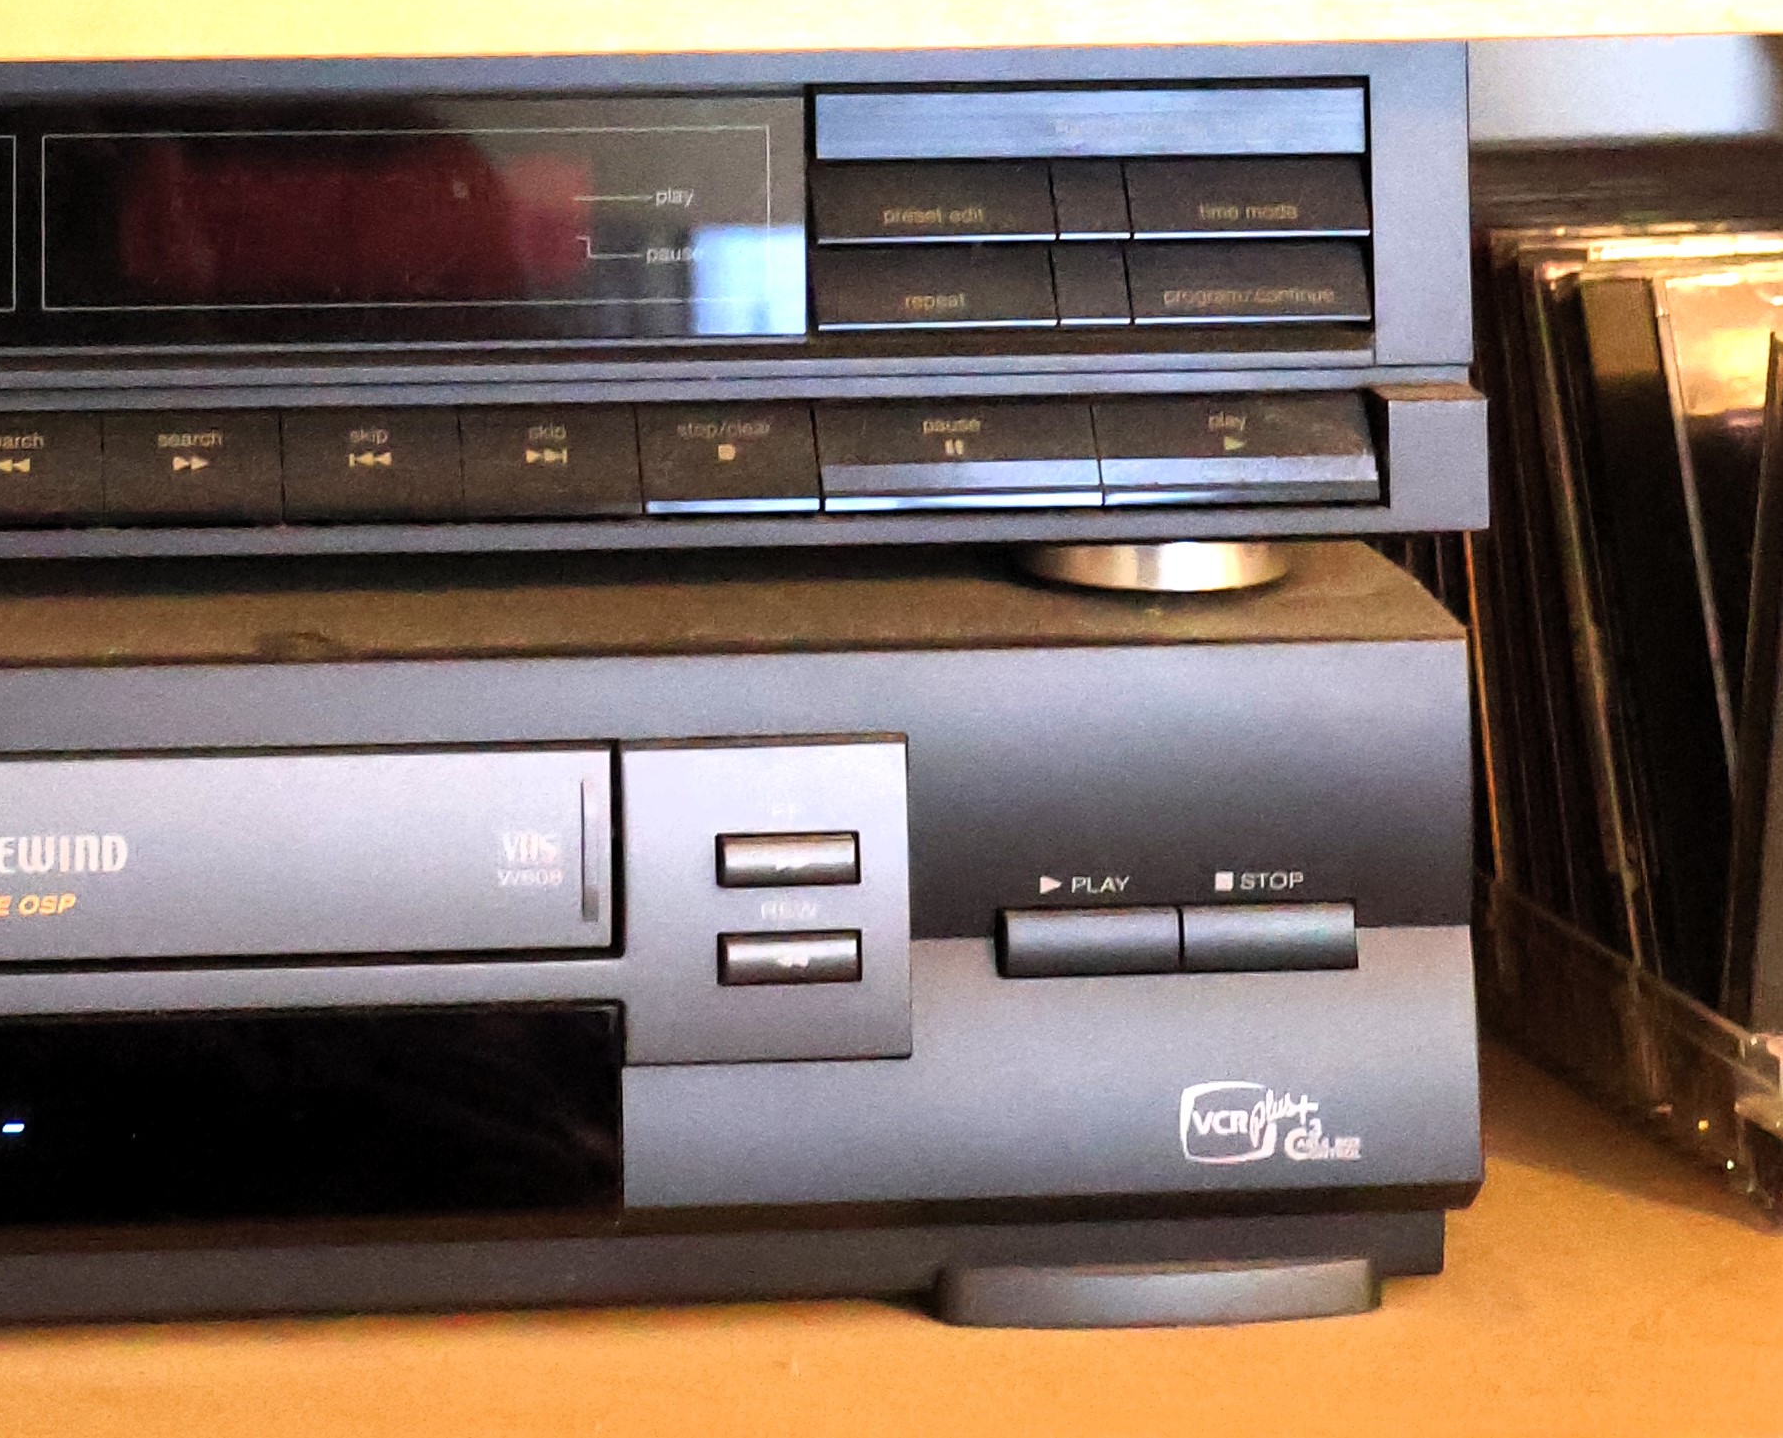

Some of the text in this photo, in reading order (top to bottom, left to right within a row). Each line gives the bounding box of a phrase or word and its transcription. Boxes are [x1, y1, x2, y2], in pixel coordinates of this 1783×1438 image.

[655, 187, 695, 210] play
[882, 206, 984, 226] preset edit
[1198, 201, 1299, 220] time mode
[646, 247, 705, 265] pause
[904, 292, 965, 313] repeat
[923, 417, 981, 434] pause
[1208, 410, 1246, 431] play
[158, 431, 222, 448] search
[350, 426, 388, 445] skip
[529, 423, 567, 441] skip
[502, 833, 560, 863] VHS
[1071, 875, 1130, 893] PLAY
[1240, 871, 1304, 891] STOP
[1192, 1110, 1249, 1135] VCR
